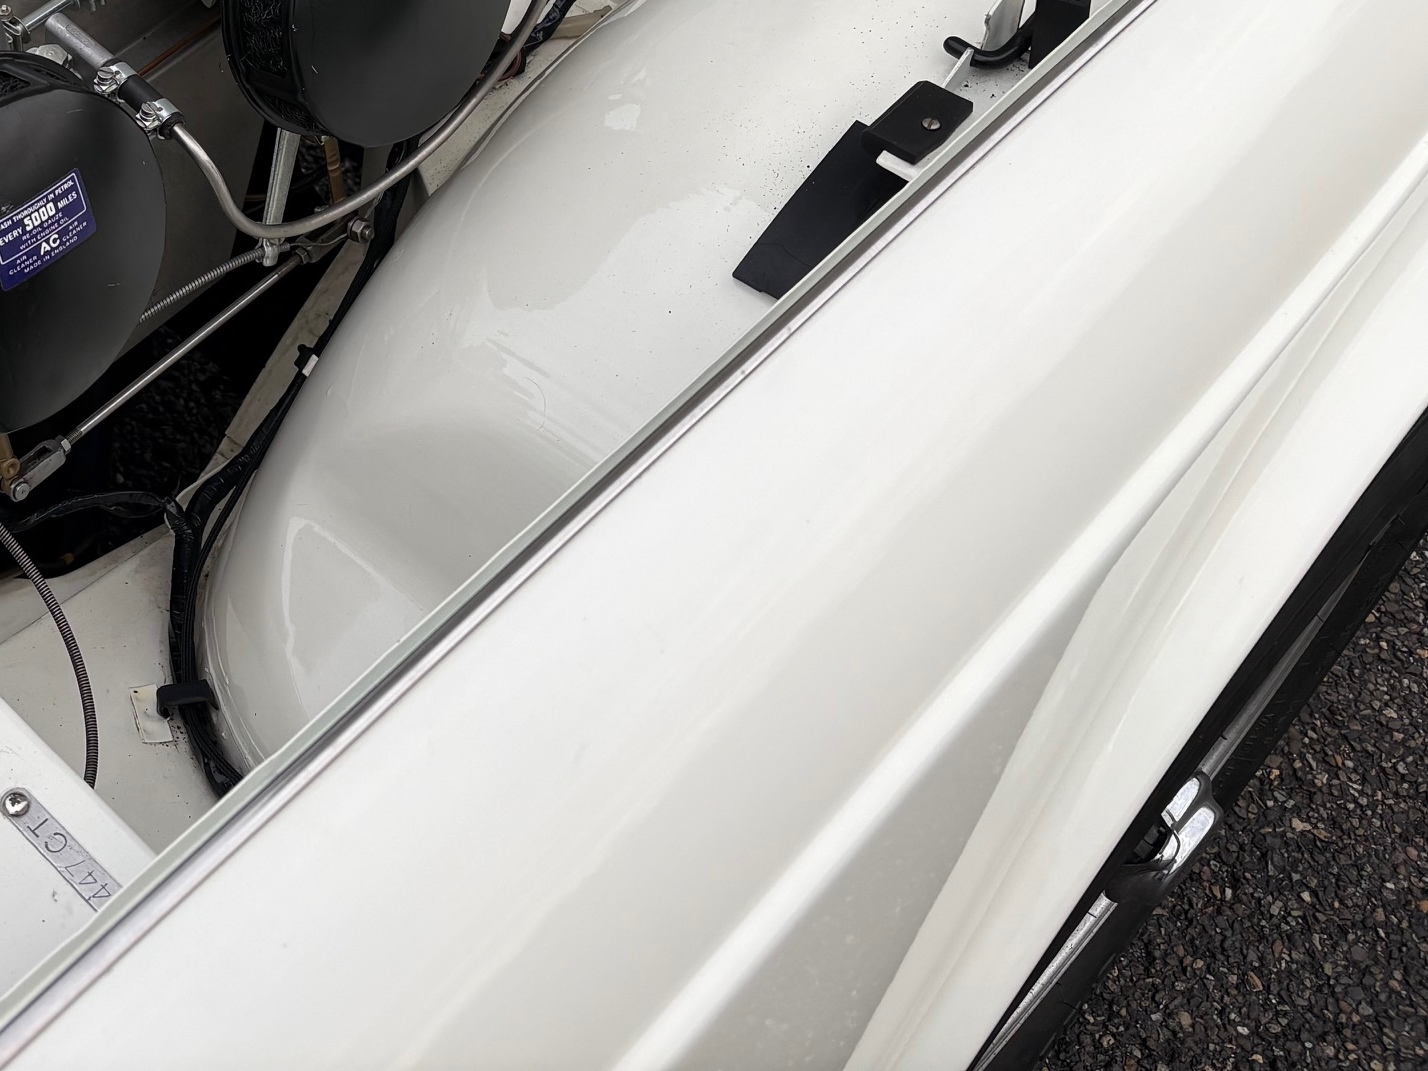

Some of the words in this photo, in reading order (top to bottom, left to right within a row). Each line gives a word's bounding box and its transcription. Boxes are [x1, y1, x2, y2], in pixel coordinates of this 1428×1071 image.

[13, 197, 47, 222] THOROUGHLY
[48, 193, 54, 201] IN
[55, 179, 74, 196] PETROL
[24, 202, 56, 231] 5000
[57, 191, 77, 209] MILES
[20, 238, 36, 250] WITH
[38, 223, 58, 239] ENGINE
[60, 217, 69, 225] OIL
[22, 227, 42, 240] RE-OIL
[44, 212, 63, 227] GAUZE
[62, 222, 87, 241] CLEANER
[69, 221, 78, 230] AIR
[24, 261, 42, 273] MADE
[52, 236, 77, 256] ENGLAND
[40, 234, 60, 255] AC
[9, 256, 37, 275] CLEANER
[16, 256, 26, 264] AIR
